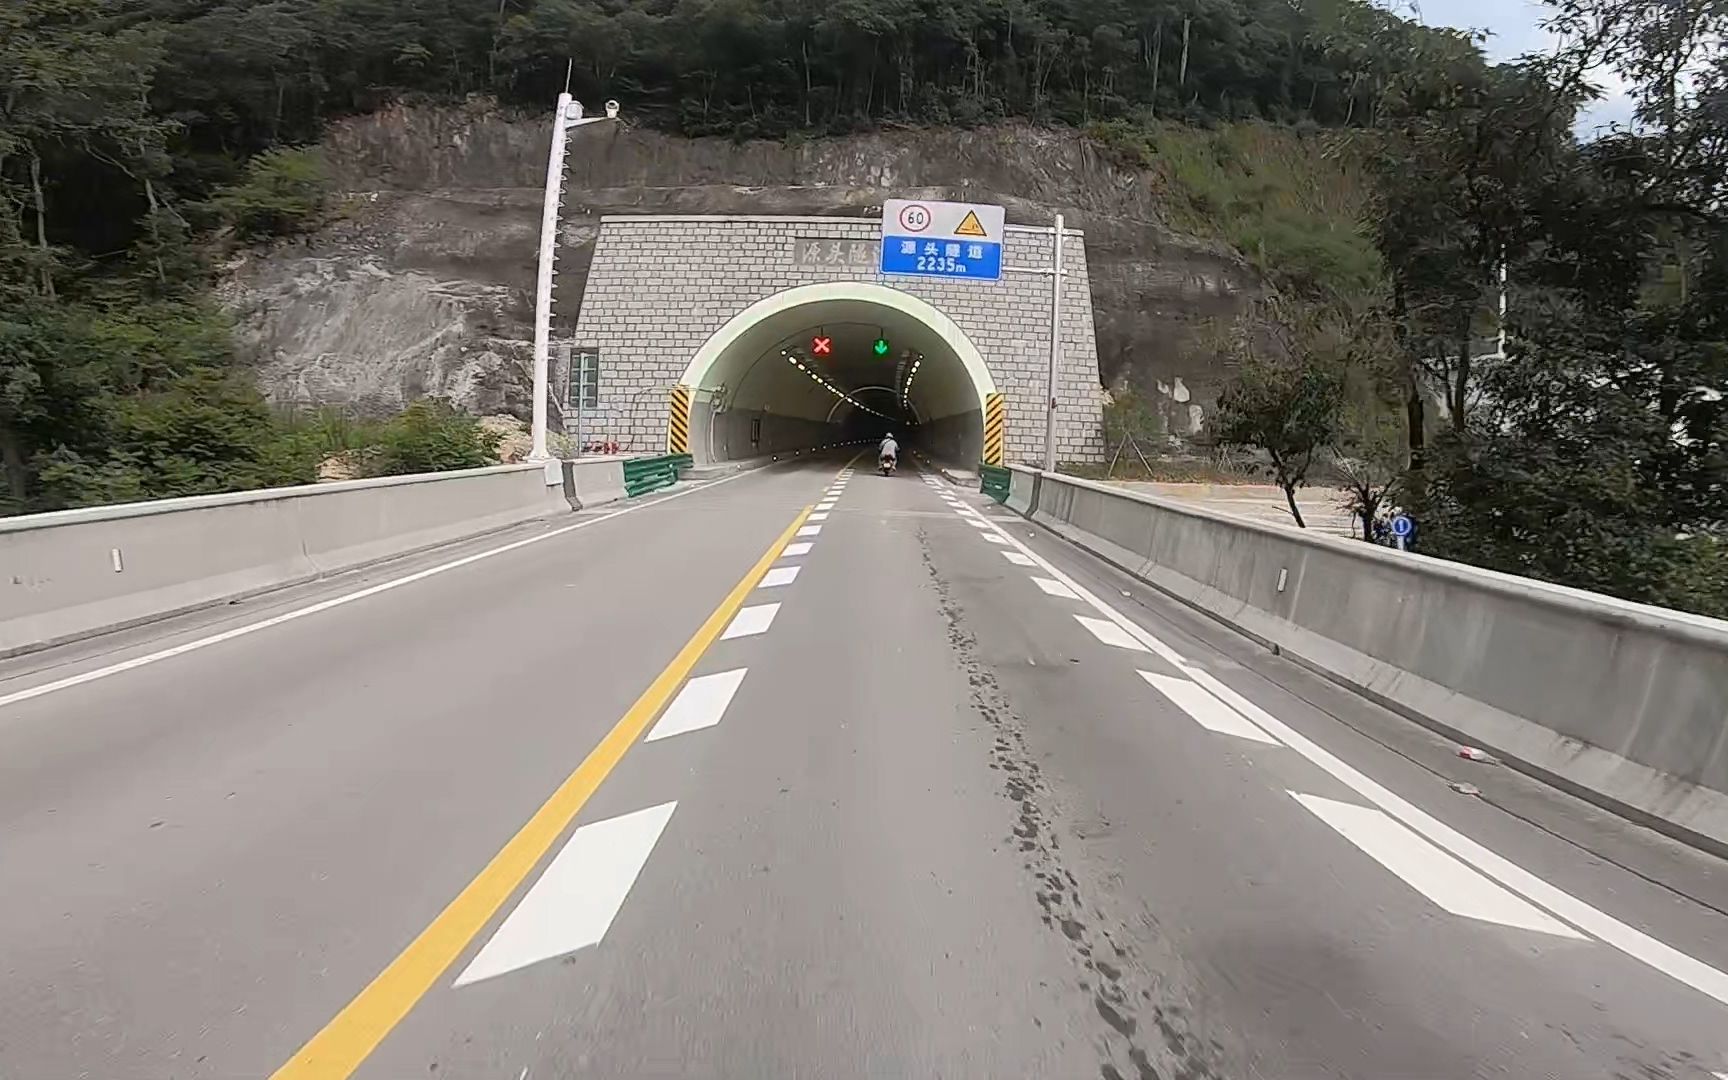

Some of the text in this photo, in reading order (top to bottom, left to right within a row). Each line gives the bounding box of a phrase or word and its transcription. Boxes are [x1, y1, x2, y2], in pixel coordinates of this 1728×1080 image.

[908, 212, 924, 225] 60
[901, 240, 983, 259] 源头隧道
[917, 256, 967, 273] 2235m
